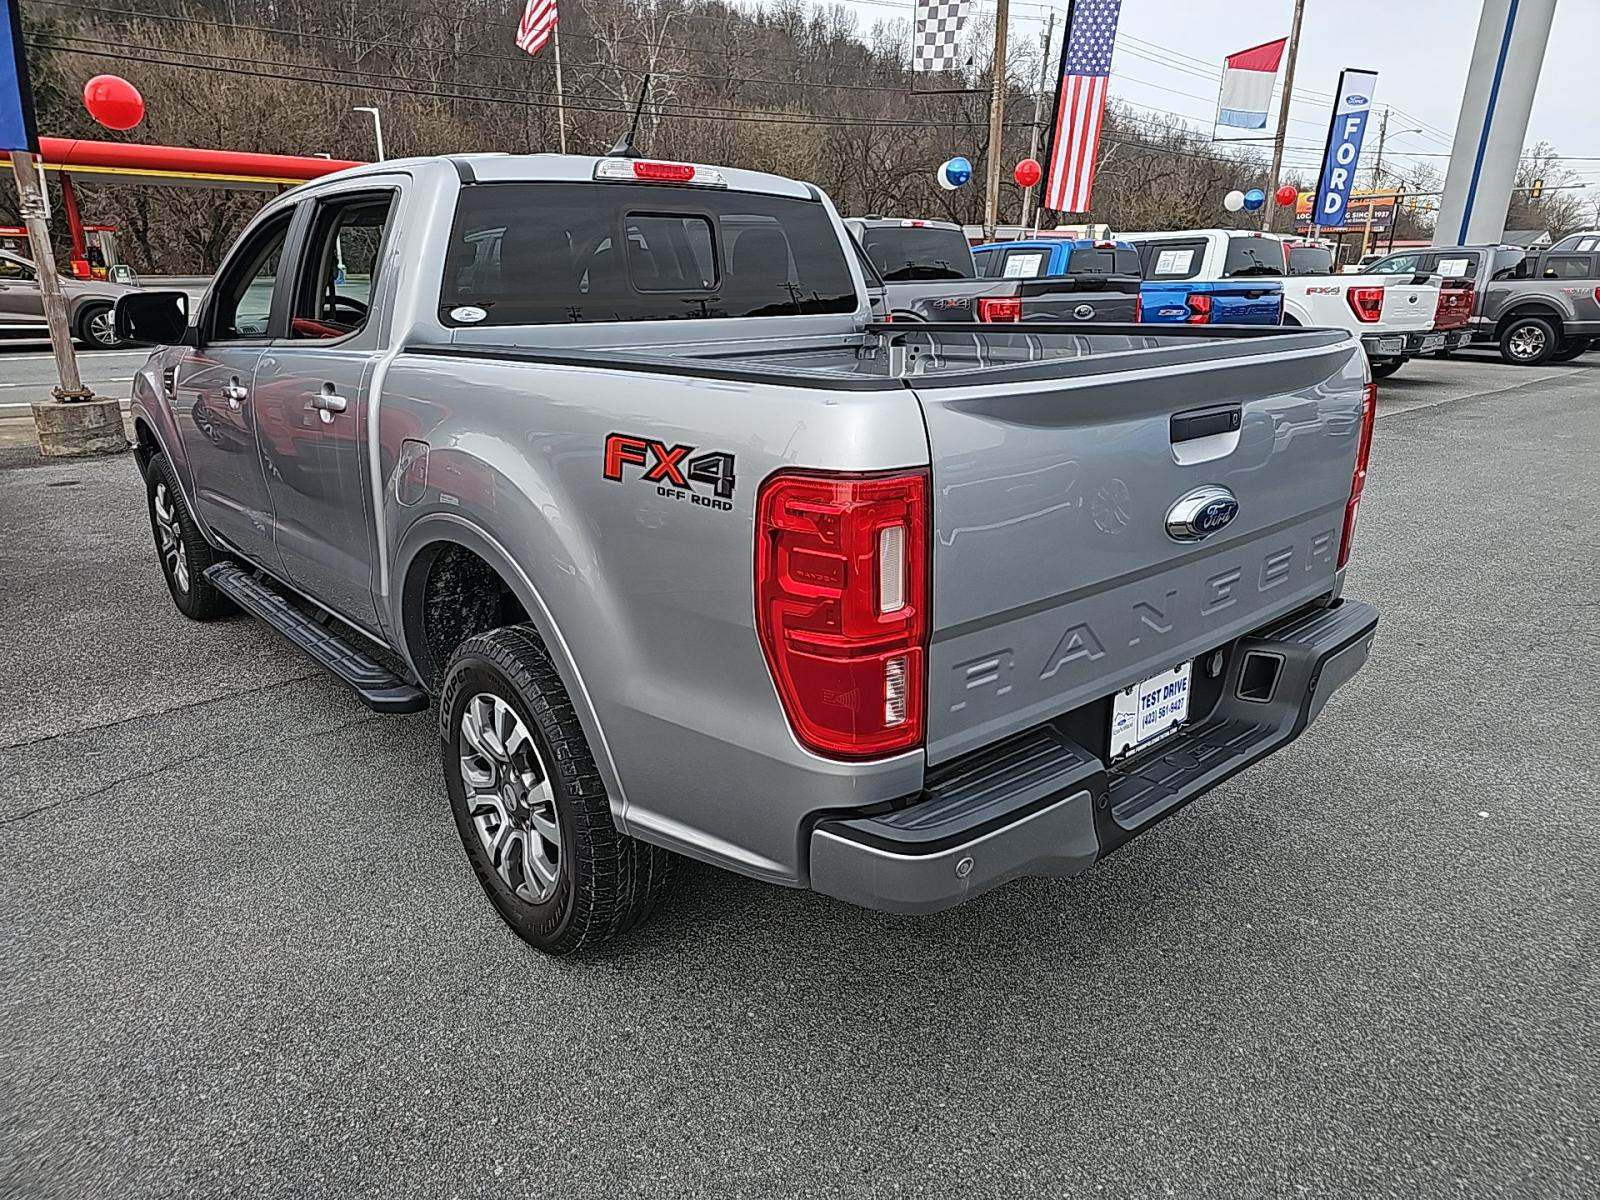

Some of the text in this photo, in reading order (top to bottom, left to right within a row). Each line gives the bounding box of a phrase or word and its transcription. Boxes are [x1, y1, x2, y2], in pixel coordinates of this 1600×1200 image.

[1324, 117, 1361, 214] FORD
[602, 431, 736, 499] FX4
[657, 486, 733, 512] OFF ROAD
[1203, 502, 1236, 530] Ford
[949, 528, 1336, 713] RANGER
[1141, 677, 1187, 711] TEST DRIVE
[1142, 709, 1158, 730] (423)
